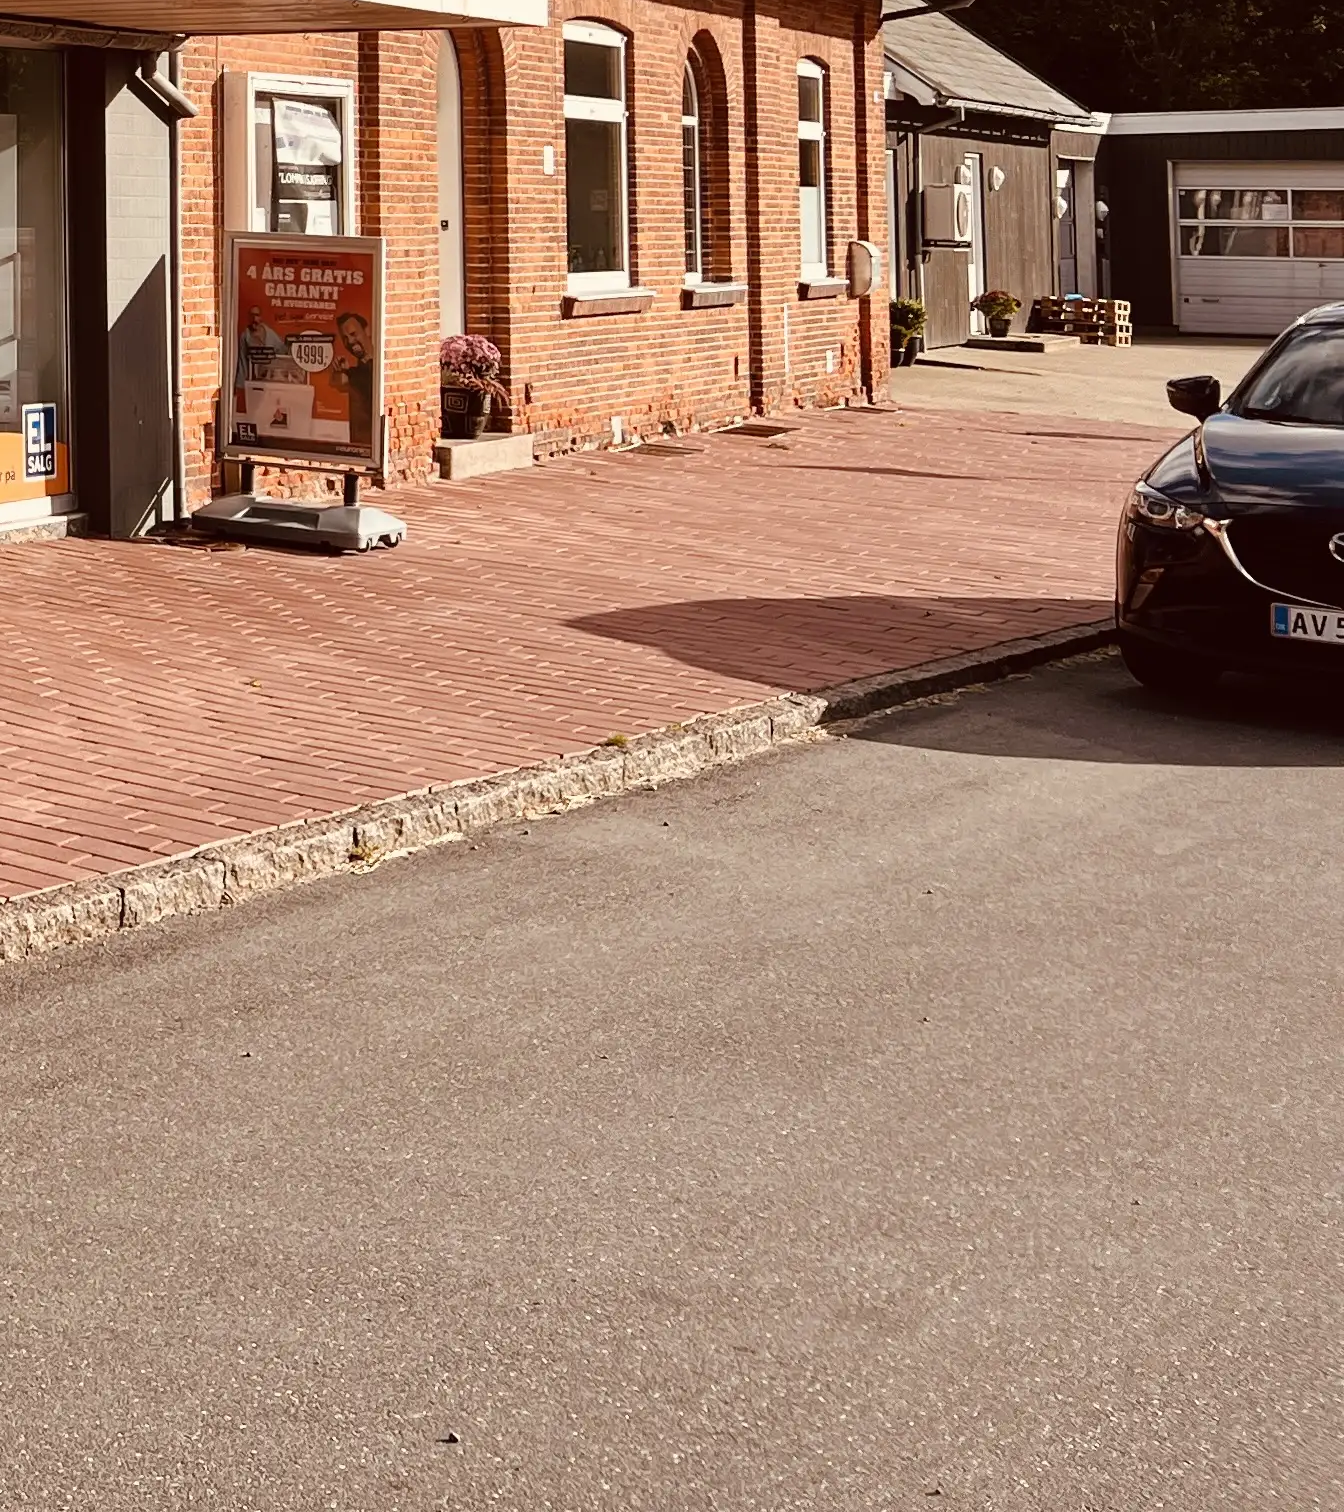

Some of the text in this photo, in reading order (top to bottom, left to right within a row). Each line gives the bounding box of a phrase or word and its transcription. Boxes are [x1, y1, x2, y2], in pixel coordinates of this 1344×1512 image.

[247, 262, 364, 285] 4 ÅRS GRATIS
[26, 412, 52, 454] EL
[27, 453, 52, 473] SALG
[5, 466, 17, 484] på
[1292, 612, 1328, 636] AV
